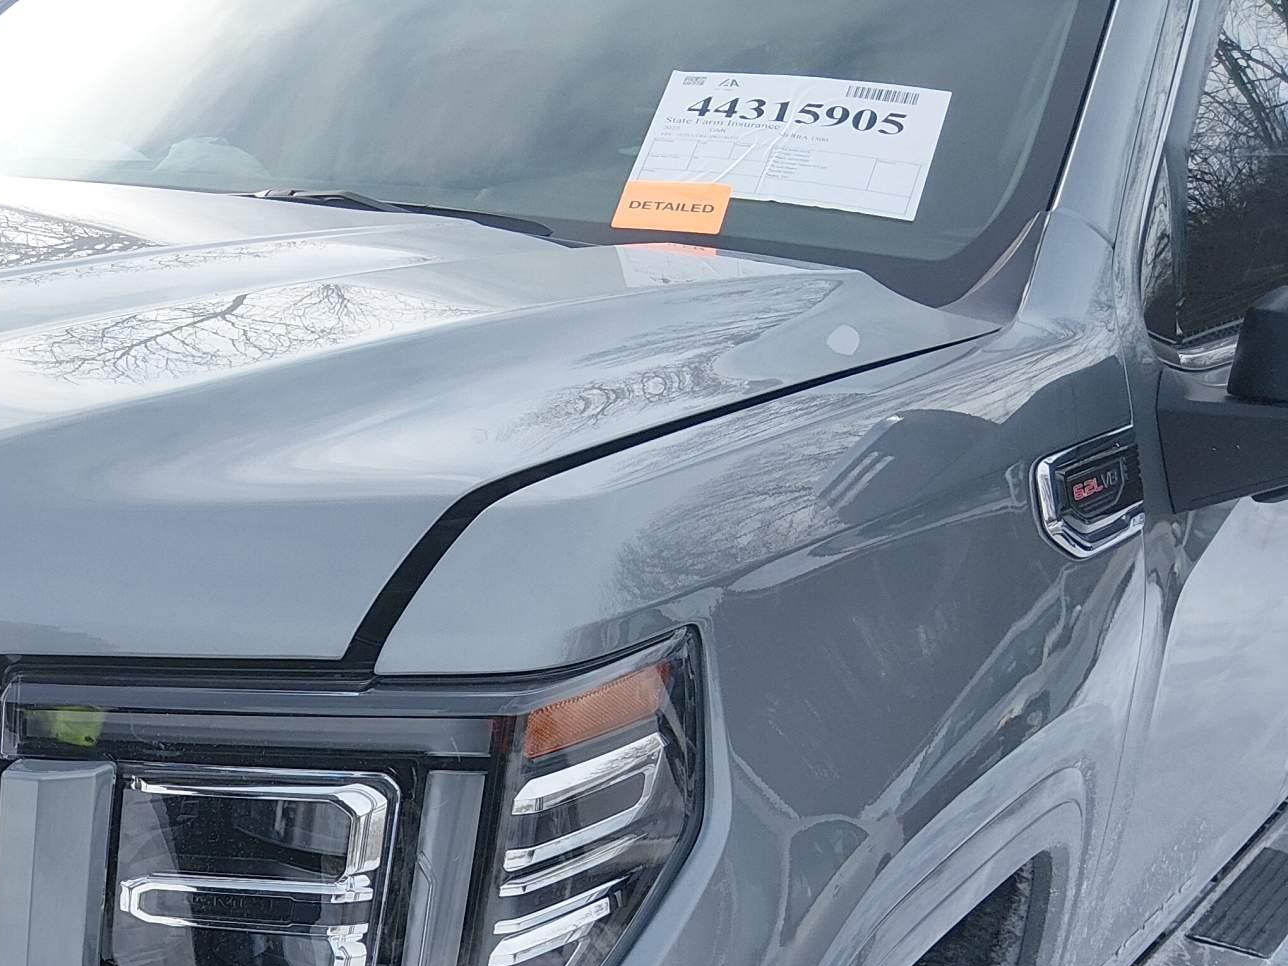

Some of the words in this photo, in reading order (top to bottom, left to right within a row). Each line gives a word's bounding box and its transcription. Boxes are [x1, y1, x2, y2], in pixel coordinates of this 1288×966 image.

[665, 116, 693, 125] State
[696, 117, 724, 126] Farm
[727, 120, 781, 131] Insurance
[687, 96, 907, 136] 44315905
[628, 200, 715, 214] DETAILED
